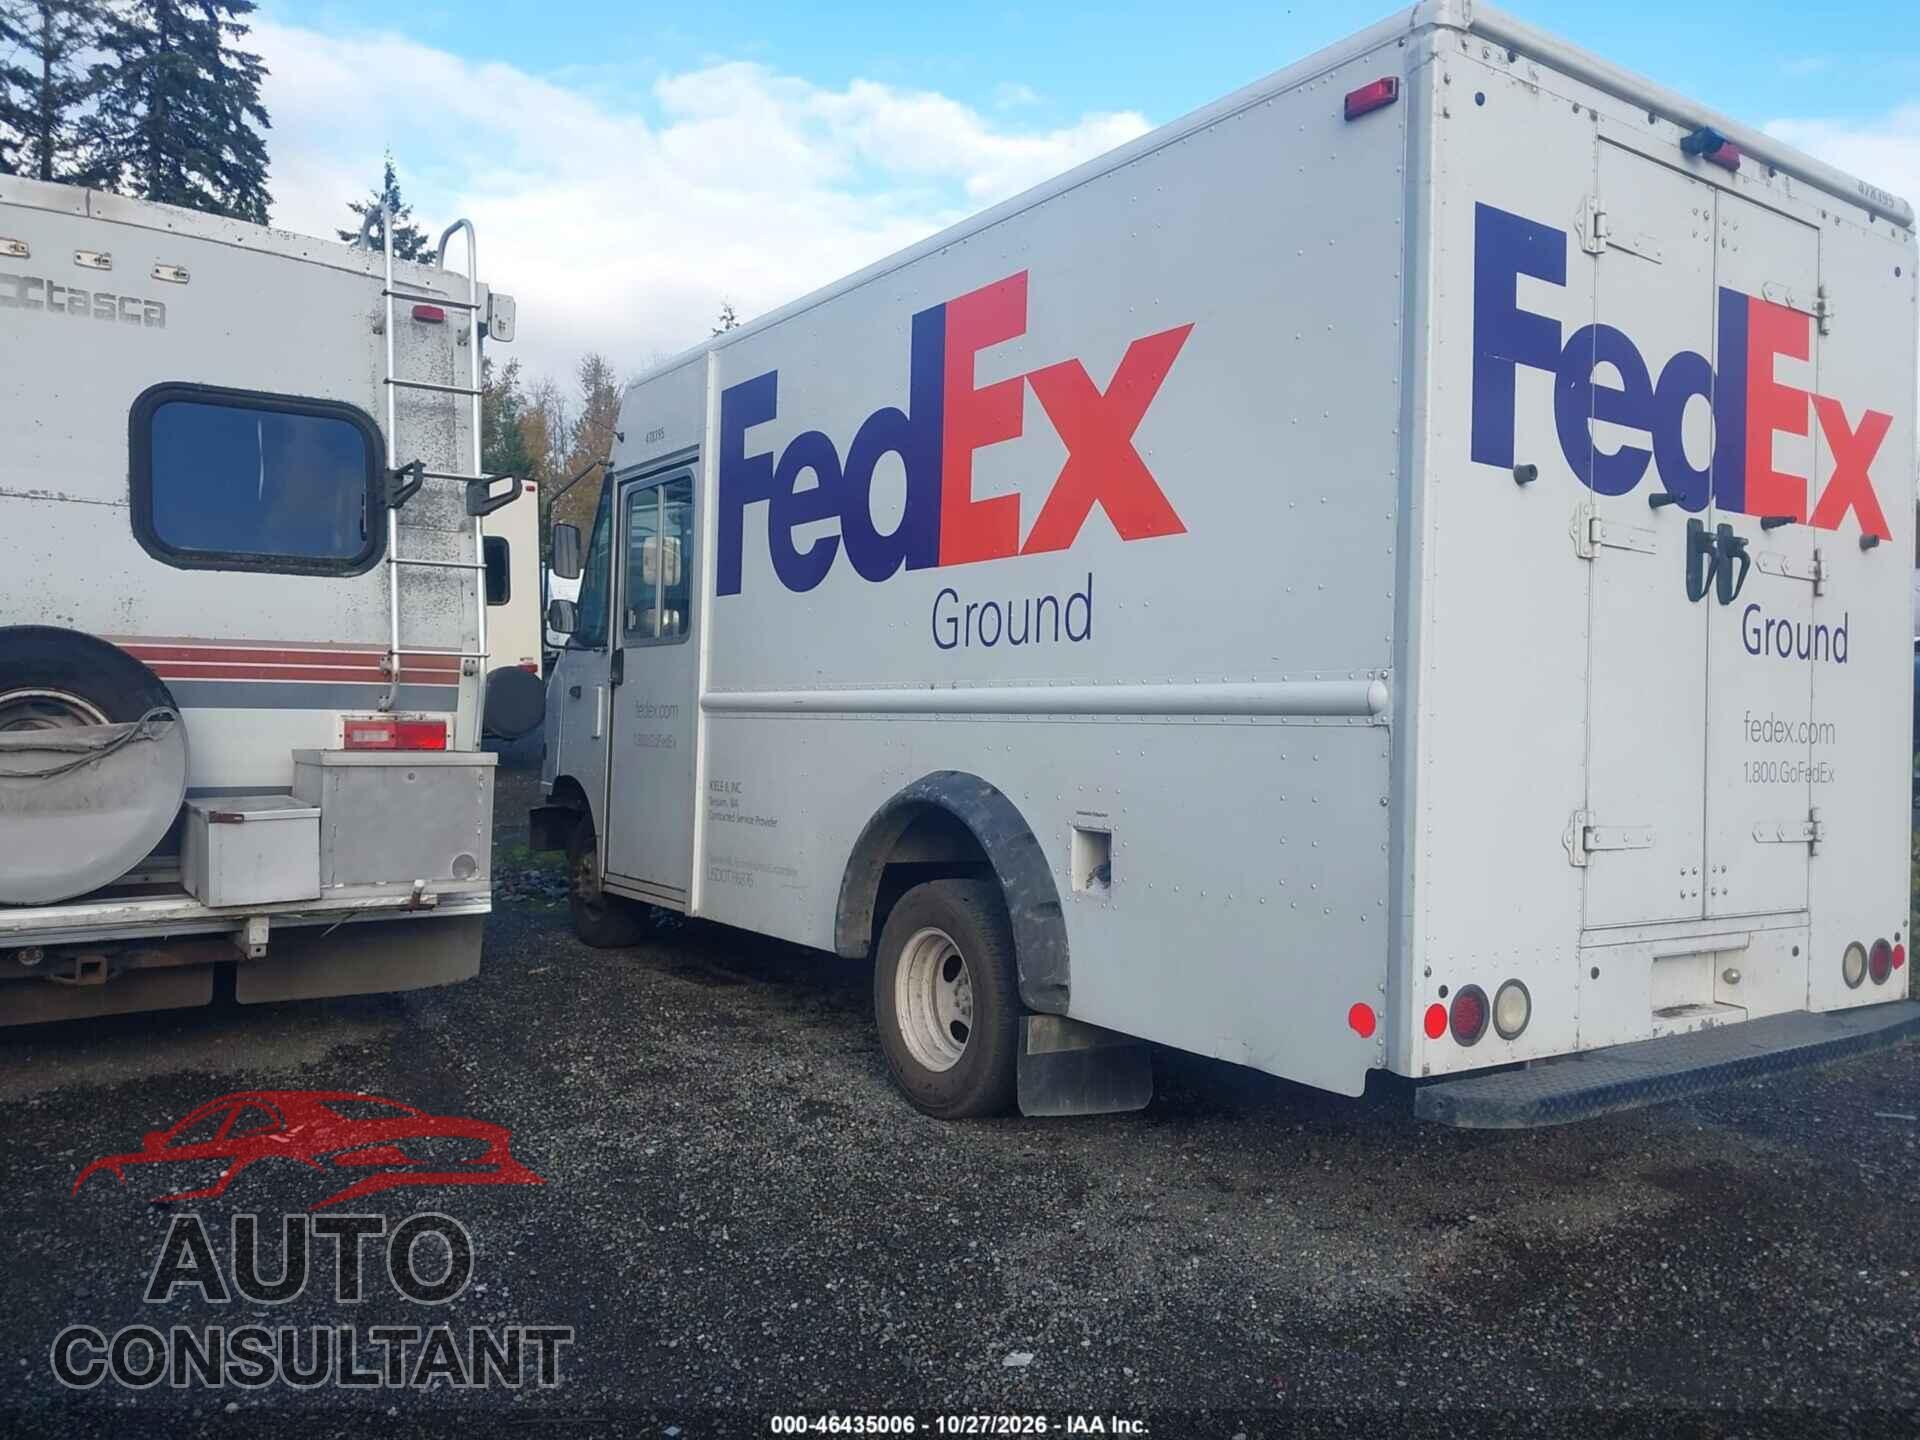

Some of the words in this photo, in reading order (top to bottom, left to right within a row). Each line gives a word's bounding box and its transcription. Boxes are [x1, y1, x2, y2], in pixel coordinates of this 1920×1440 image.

[1471, 201, 1894, 541] FedEx
[716, 269, 1195, 597] FedEx
[932, 572, 1093, 650] Ground
[1742, 603, 1849, 664] Ground
[1744, 710, 1836, 744] fedex.com
[1743, 760, 1835, 783] 1.800.GoFedEx
